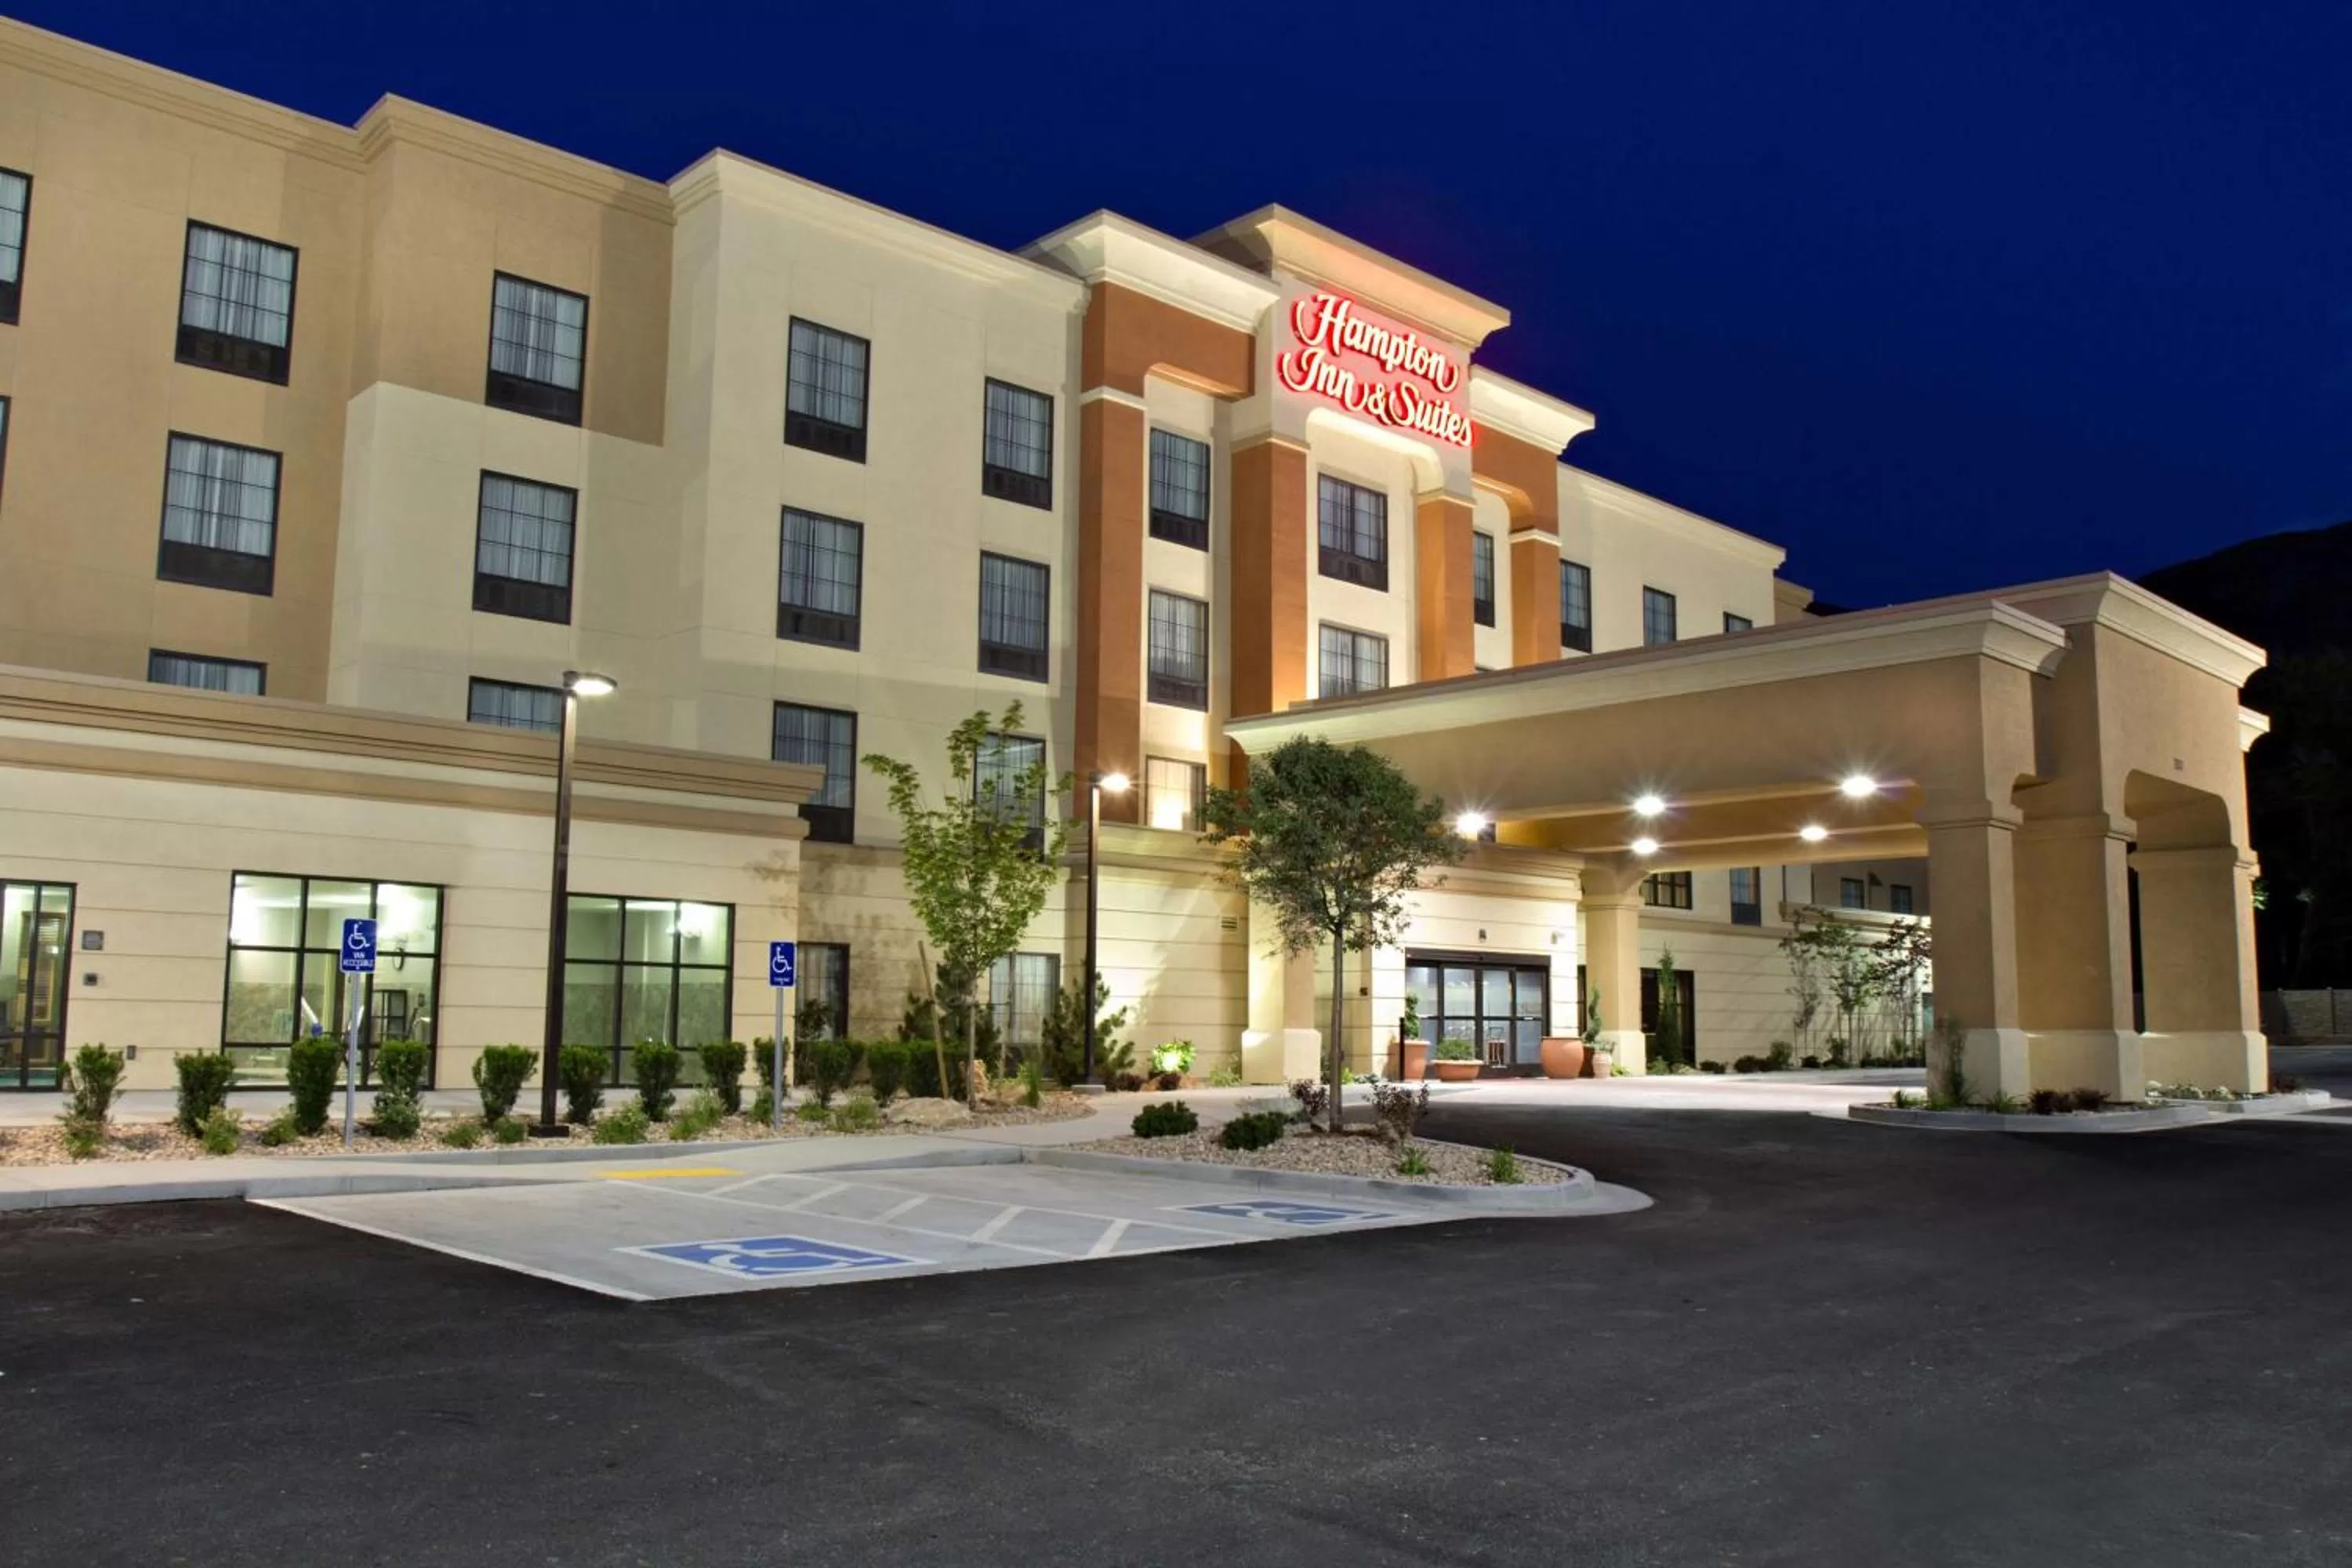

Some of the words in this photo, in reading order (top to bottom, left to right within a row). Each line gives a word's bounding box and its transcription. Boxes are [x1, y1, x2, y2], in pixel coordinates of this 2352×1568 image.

[1292, 294, 1459, 393] Hampton
[1278, 347, 1369, 412] Inn
[1367, 382, 1392, 425] &
[1388, 381, 1473, 446] Suites
